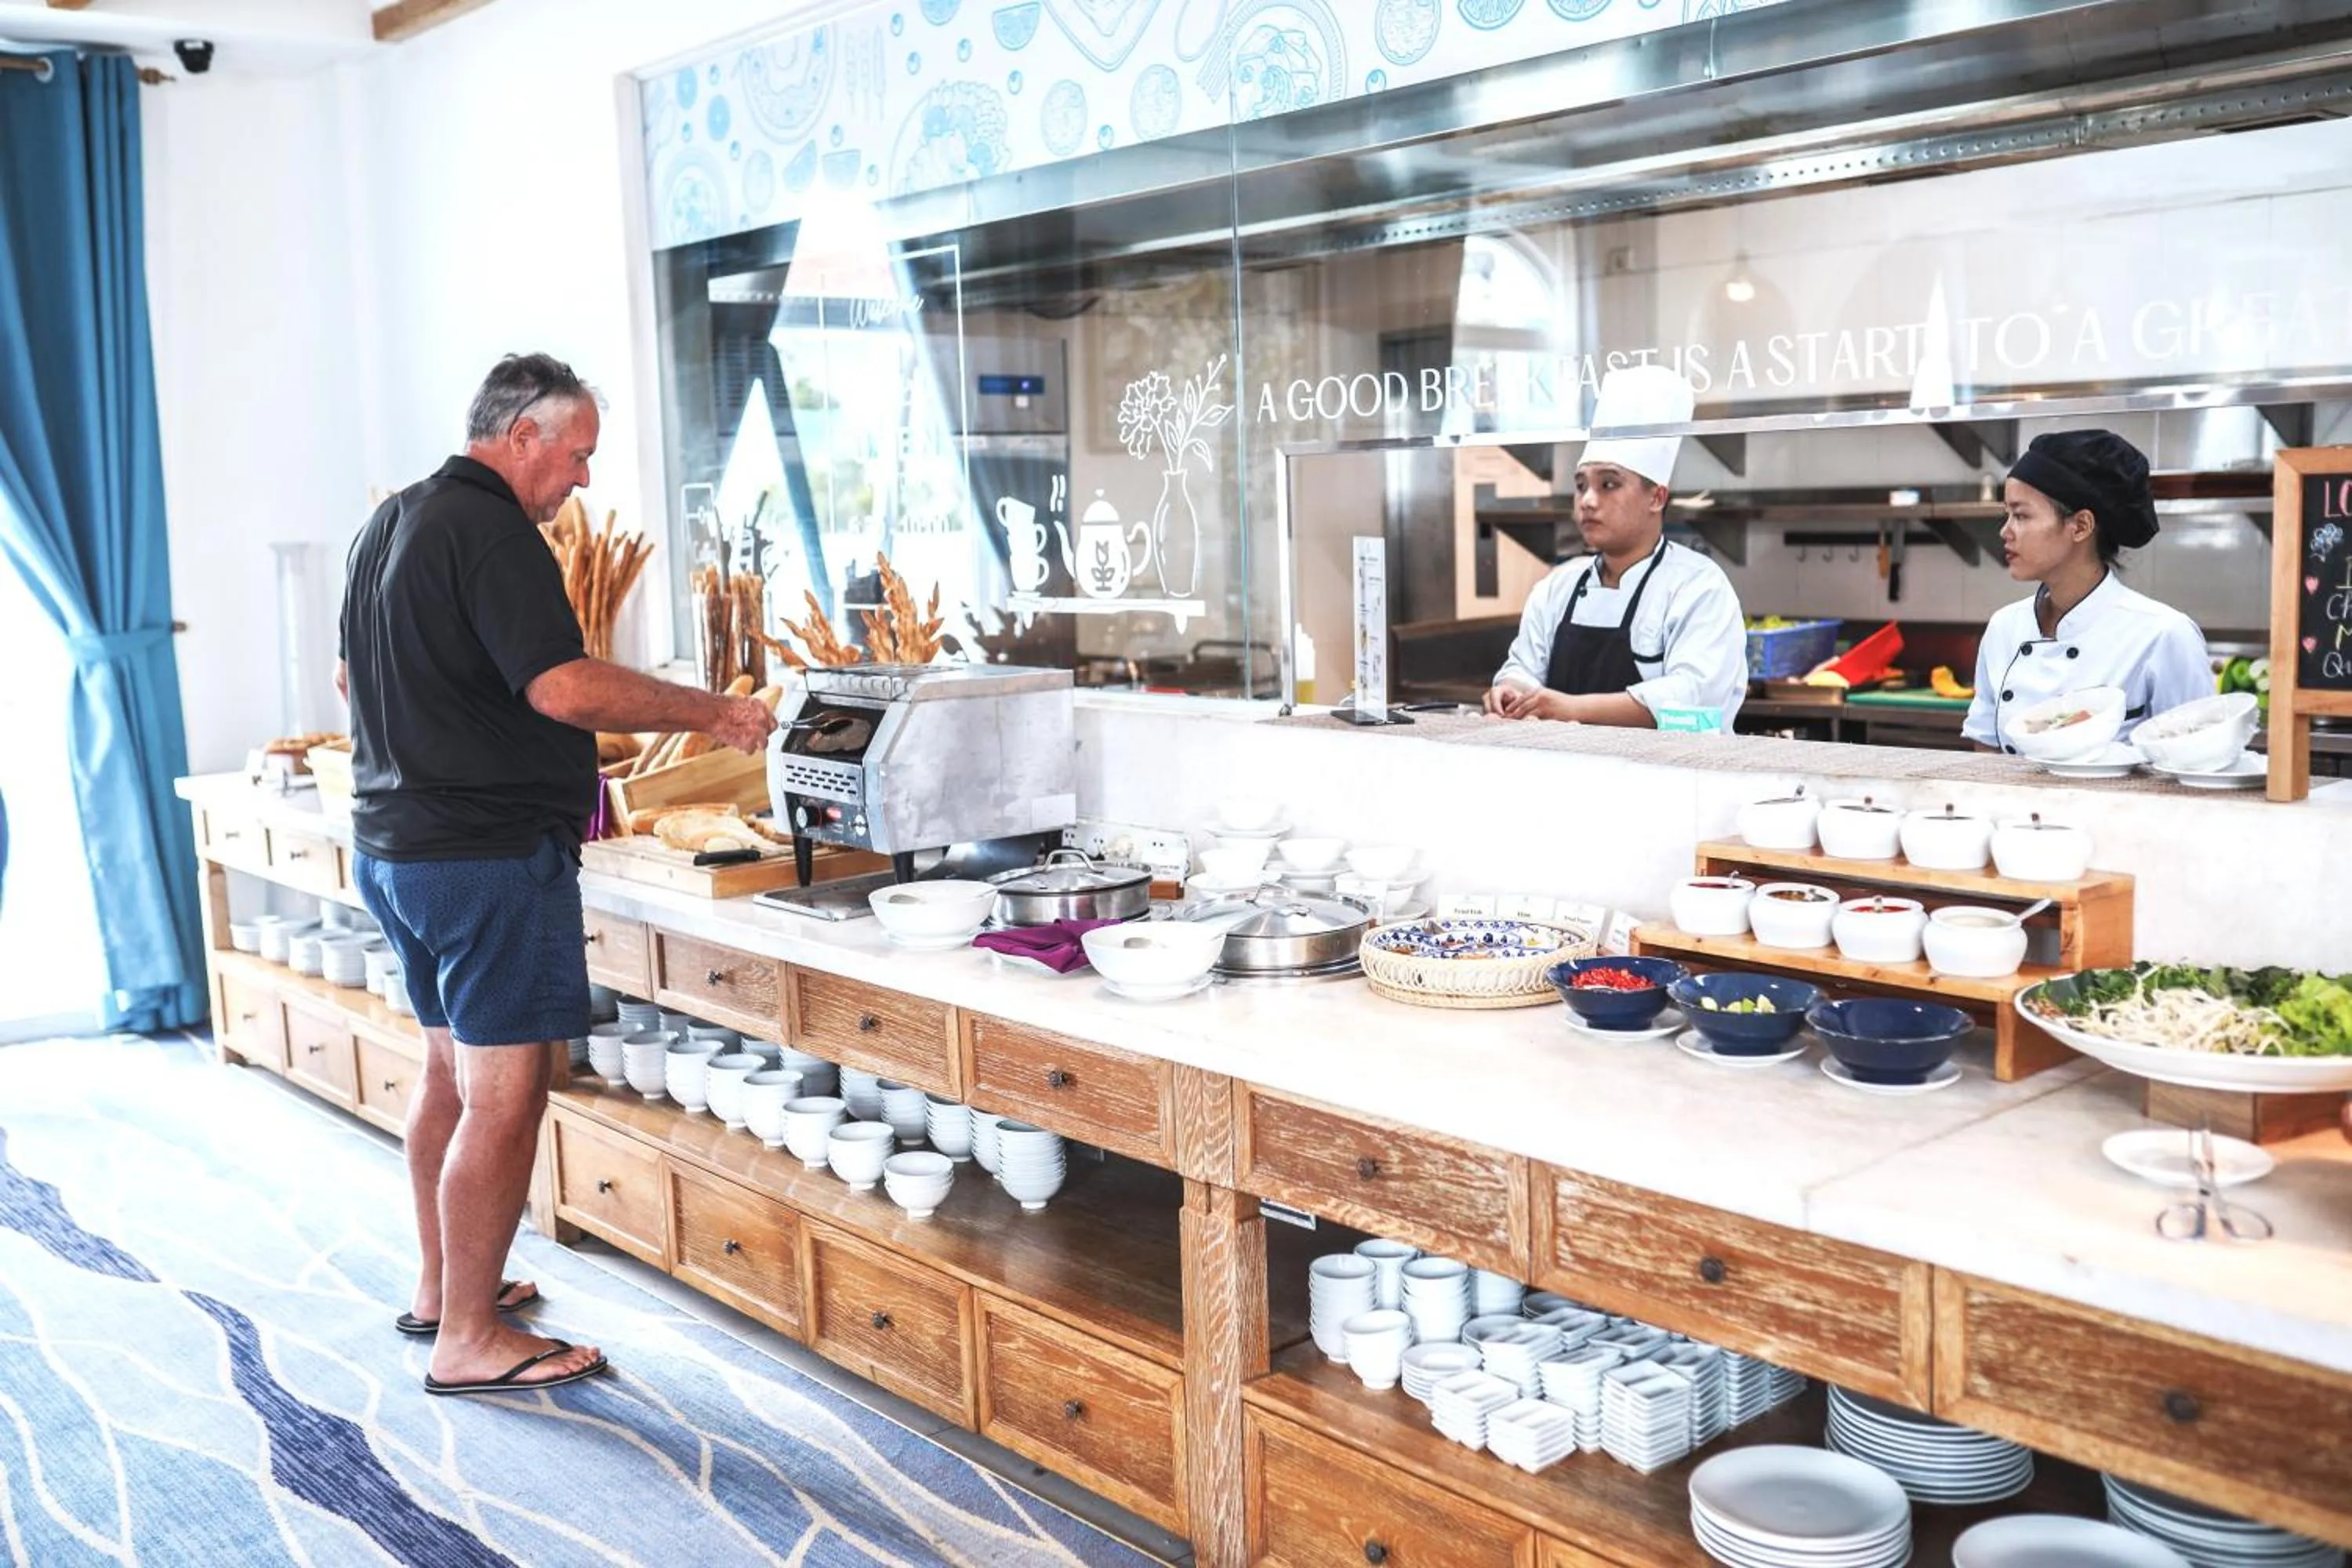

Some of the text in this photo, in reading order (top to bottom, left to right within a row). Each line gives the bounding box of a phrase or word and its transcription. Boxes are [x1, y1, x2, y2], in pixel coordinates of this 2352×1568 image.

[849, 294, 924, 329] Welce
[1257, 383, 1278, 423] A
[1287, 371, 1409, 421] GOOD
[1420, 348, 1659, 412] BREKFAT
[1673, 343, 1711, 393] IS
[1726, 339, 1757, 390] A
[1766, 323, 1928, 387] START
[1956, 311, 2051, 372] TO
[2071, 312, 2109, 365] A
